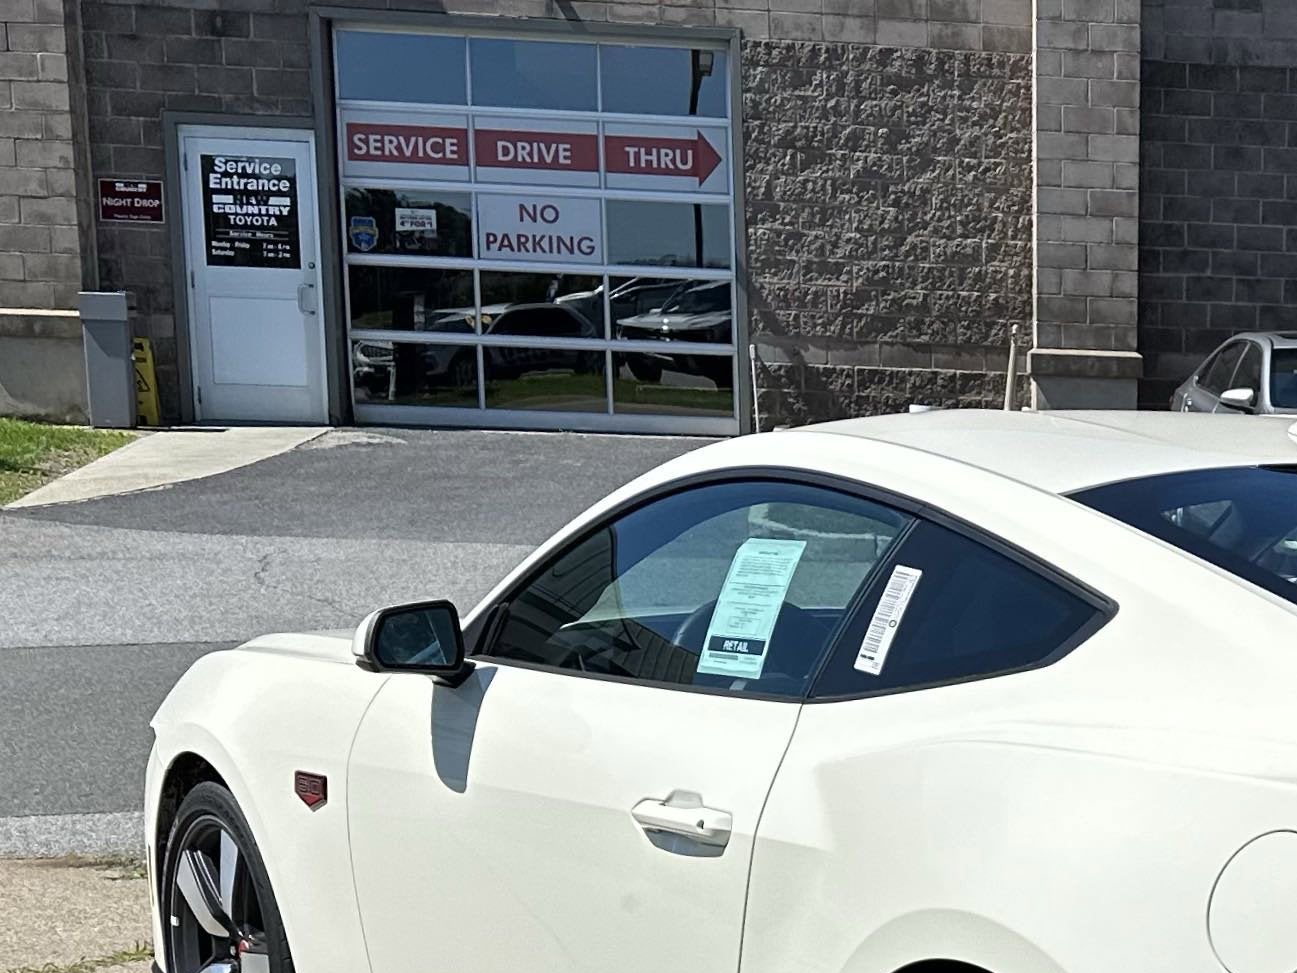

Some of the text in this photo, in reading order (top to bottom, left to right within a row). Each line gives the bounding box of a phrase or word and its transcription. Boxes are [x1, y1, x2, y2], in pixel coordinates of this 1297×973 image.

[352, 133, 694, 171] SERVICE DRIVE THRU
[213, 157, 282, 175] Service
[208, 173, 290, 191] Entrance
[212, 204, 291, 216] COUNTRY
[518, 202, 560, 224] NO
[228, 215, 278, 226] TOYOTA
[485, 232, 597, 257] PARKING
[722, 640, 749, 653] RETAIL
